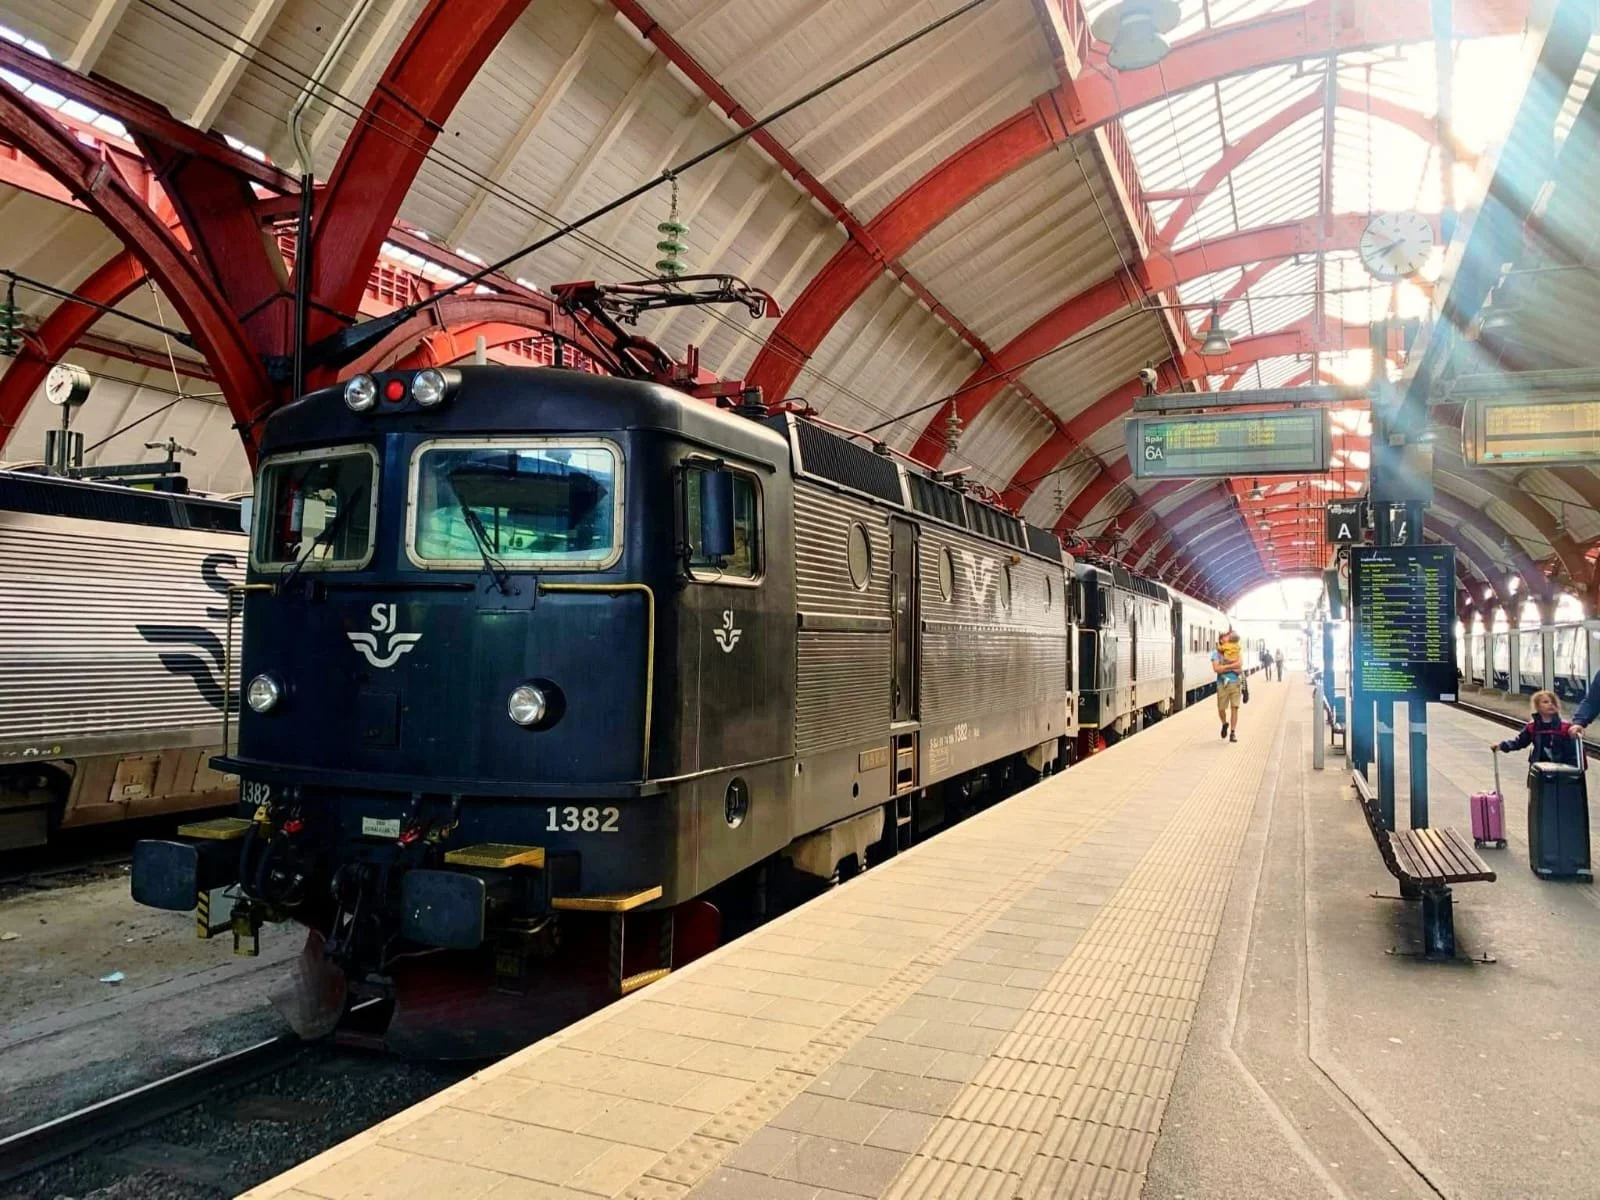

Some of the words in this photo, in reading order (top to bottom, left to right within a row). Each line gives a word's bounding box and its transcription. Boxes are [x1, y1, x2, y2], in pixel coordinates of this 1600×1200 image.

[1145, 446, 1163, 460] 6A
[1337, 522, 1352, 539] A
[371, 602, 397, 633] SJ
[722, 610, 734, 631] SJ
[242, 780, 270, 805] 1382
[546, 806, 620, 832] 1382
